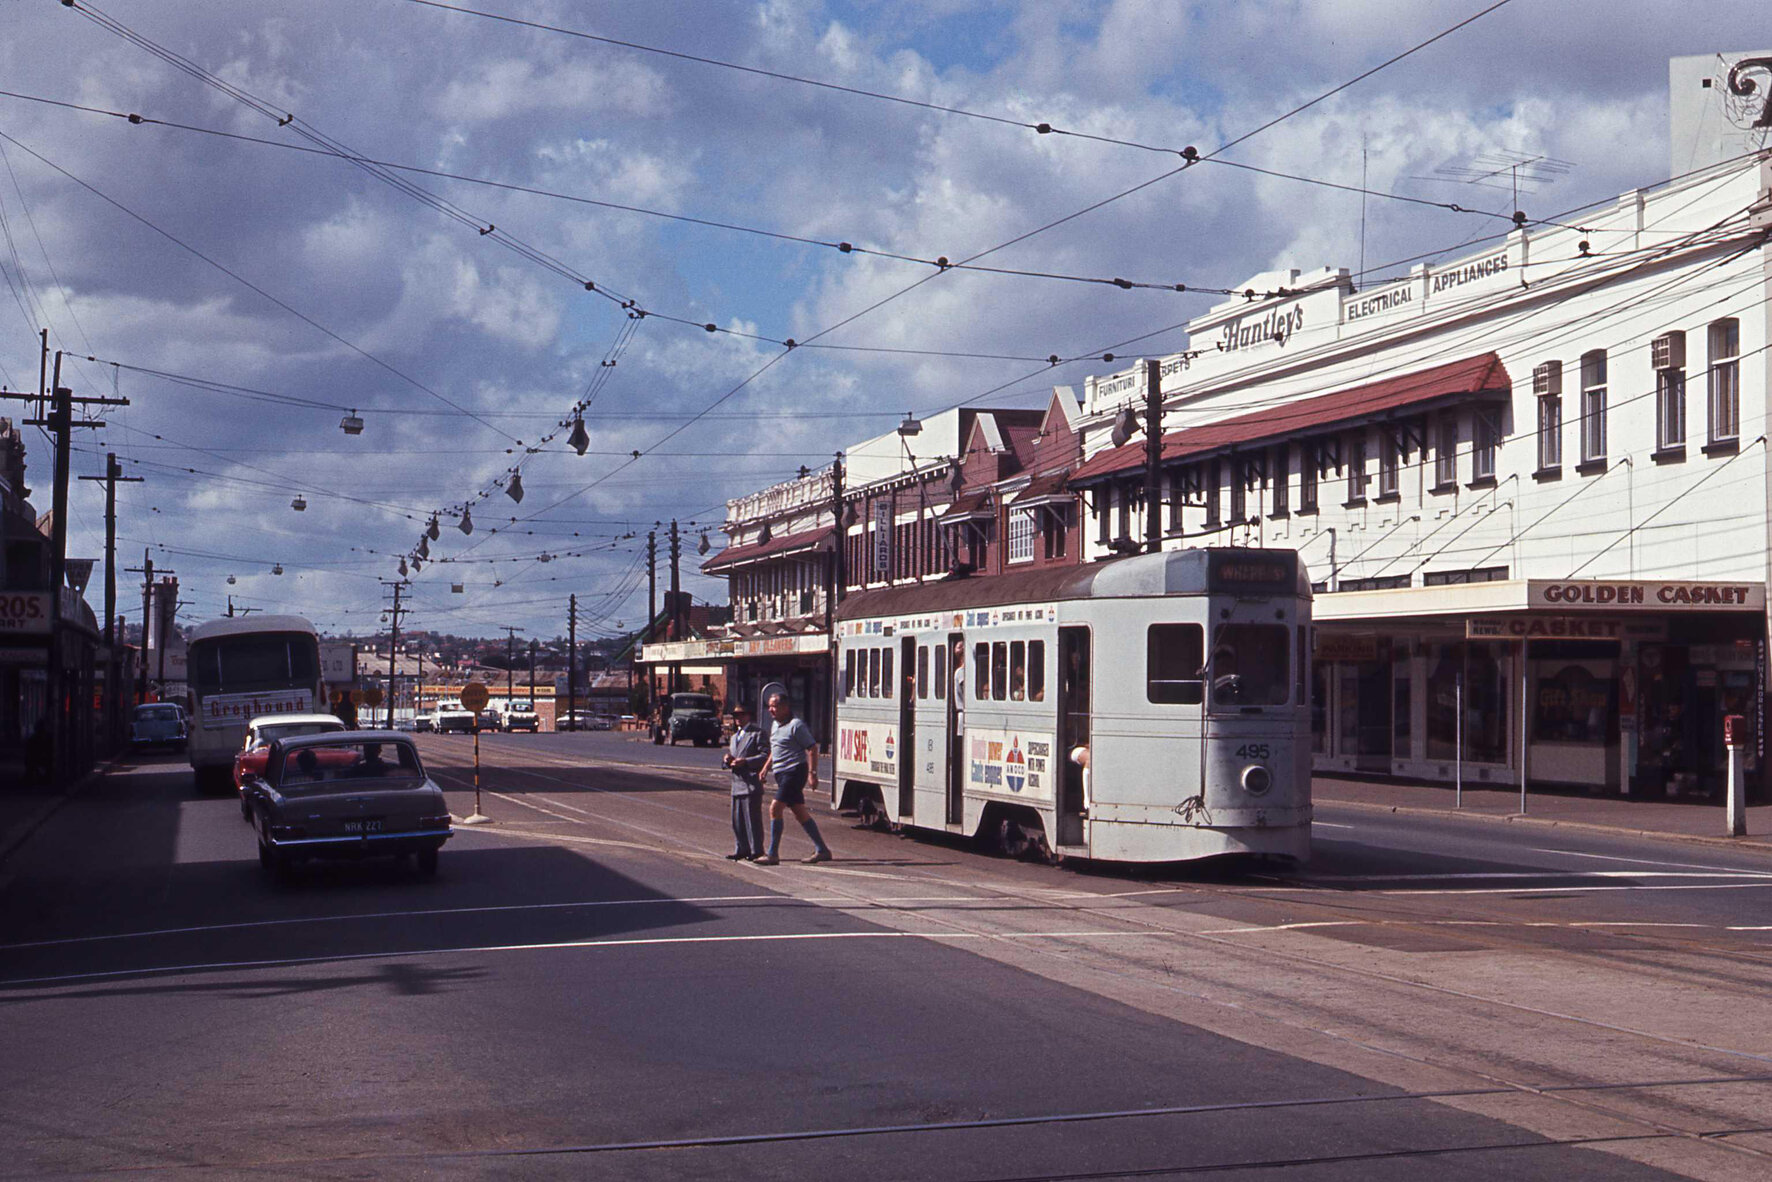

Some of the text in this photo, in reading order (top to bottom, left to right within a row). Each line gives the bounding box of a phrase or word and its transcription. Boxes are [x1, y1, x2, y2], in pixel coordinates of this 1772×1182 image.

[1433, 254, 1508, 293] APPLIANCES
[1160, 359, 1191, 378] RPETS
[879, 503, 888, 569] BILLIARDS
[1543, 585, 1750, 604] GOLDEN CASKET
[1508, 619, 1621, 636] CASKET
[211, 696, 304, 719] Greyhound
[1235, 743, 1270, 760] 495
